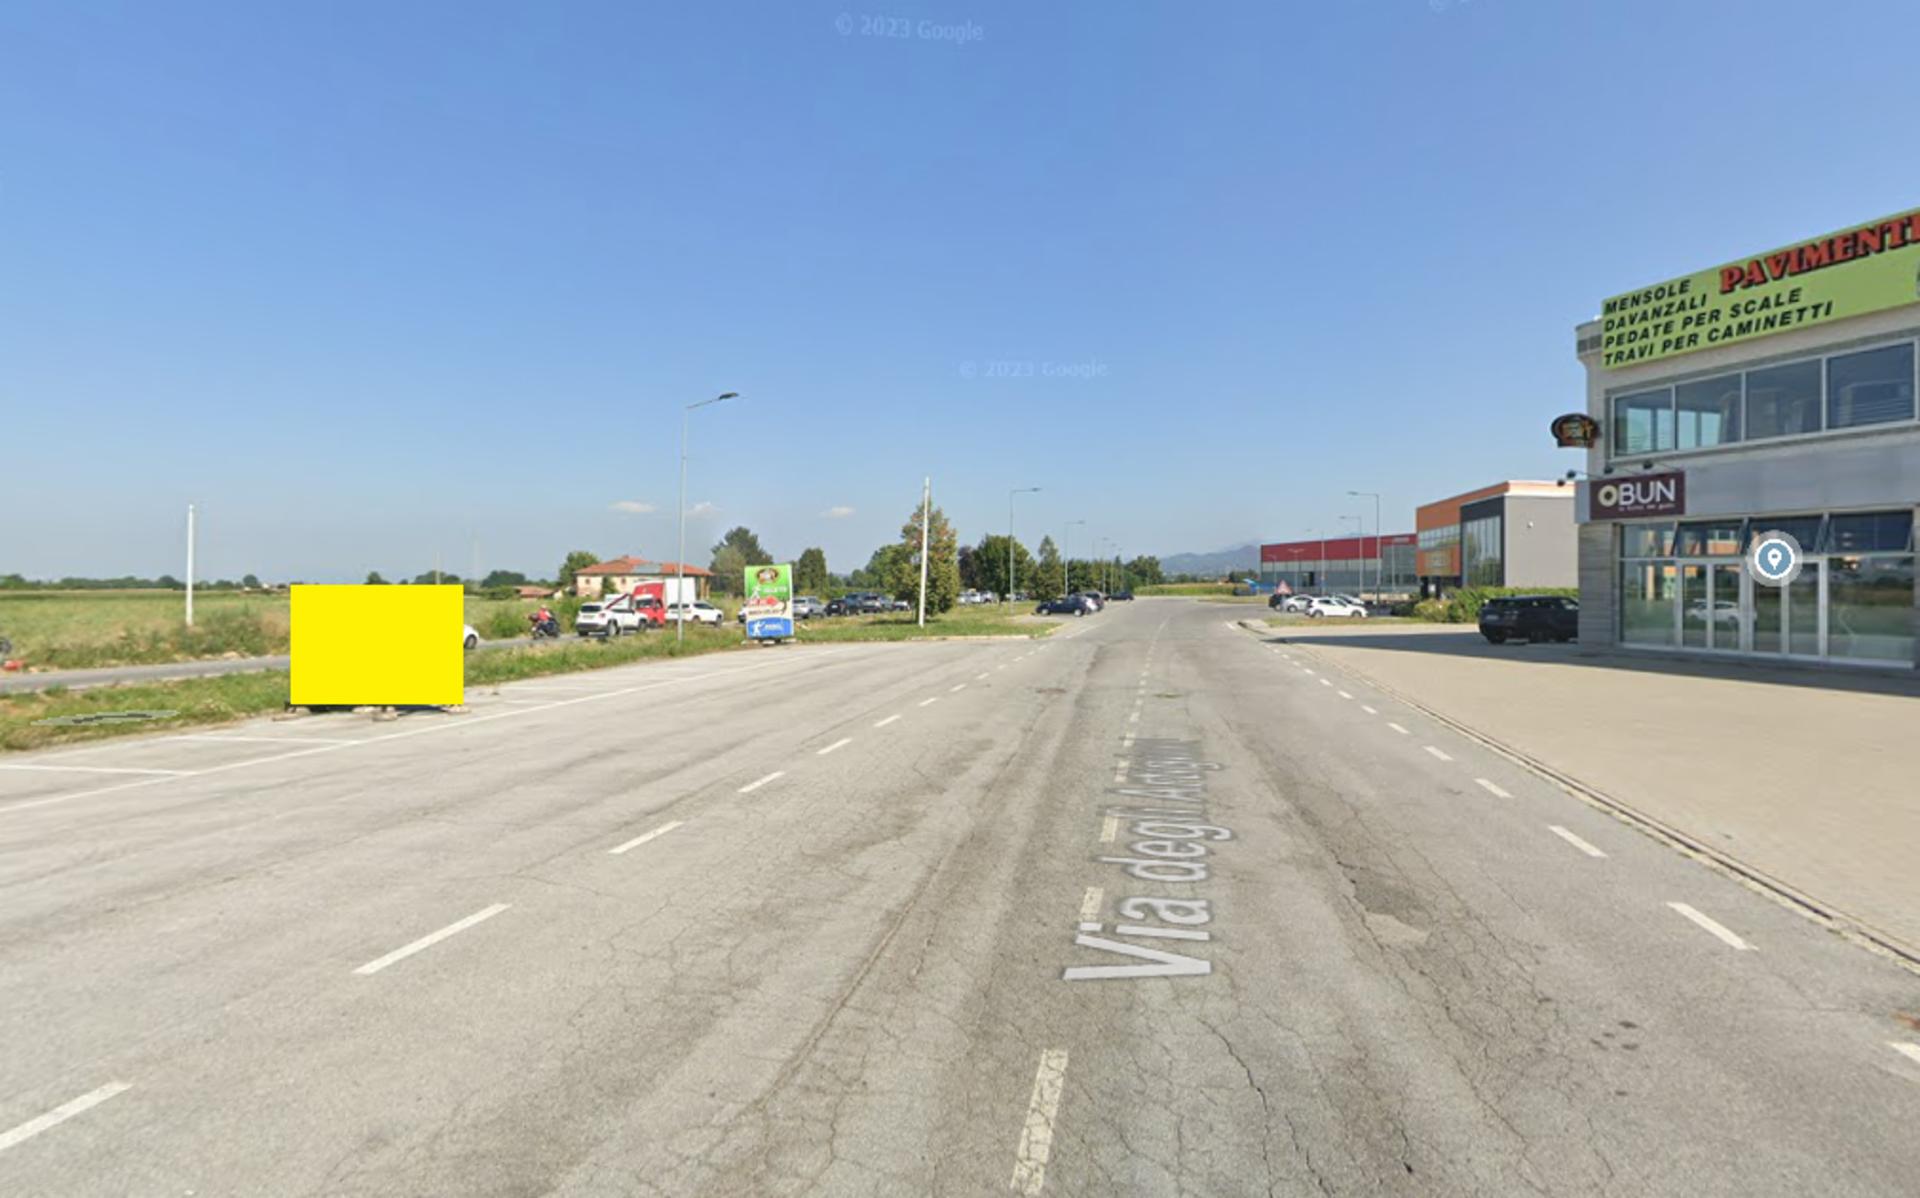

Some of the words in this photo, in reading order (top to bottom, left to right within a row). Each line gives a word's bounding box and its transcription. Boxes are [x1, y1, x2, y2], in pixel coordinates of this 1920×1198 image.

[1604, 279, 1691, 315] MENSOLE
[1605, 293, 1707, 332] DAVANZALI
[1605, 321, 1675, 348] PEDATE
[1682, 309, 1721, 330] PER
[1730, 287, 1802, 318] SCALE
[1605, 343, 1654, 366] TRAVI
[1662, 332, 1699, 353] PER
[1708, 301, 1833, 342] CAMINETTI
[1598, 478, 1676, 508] OBUN
